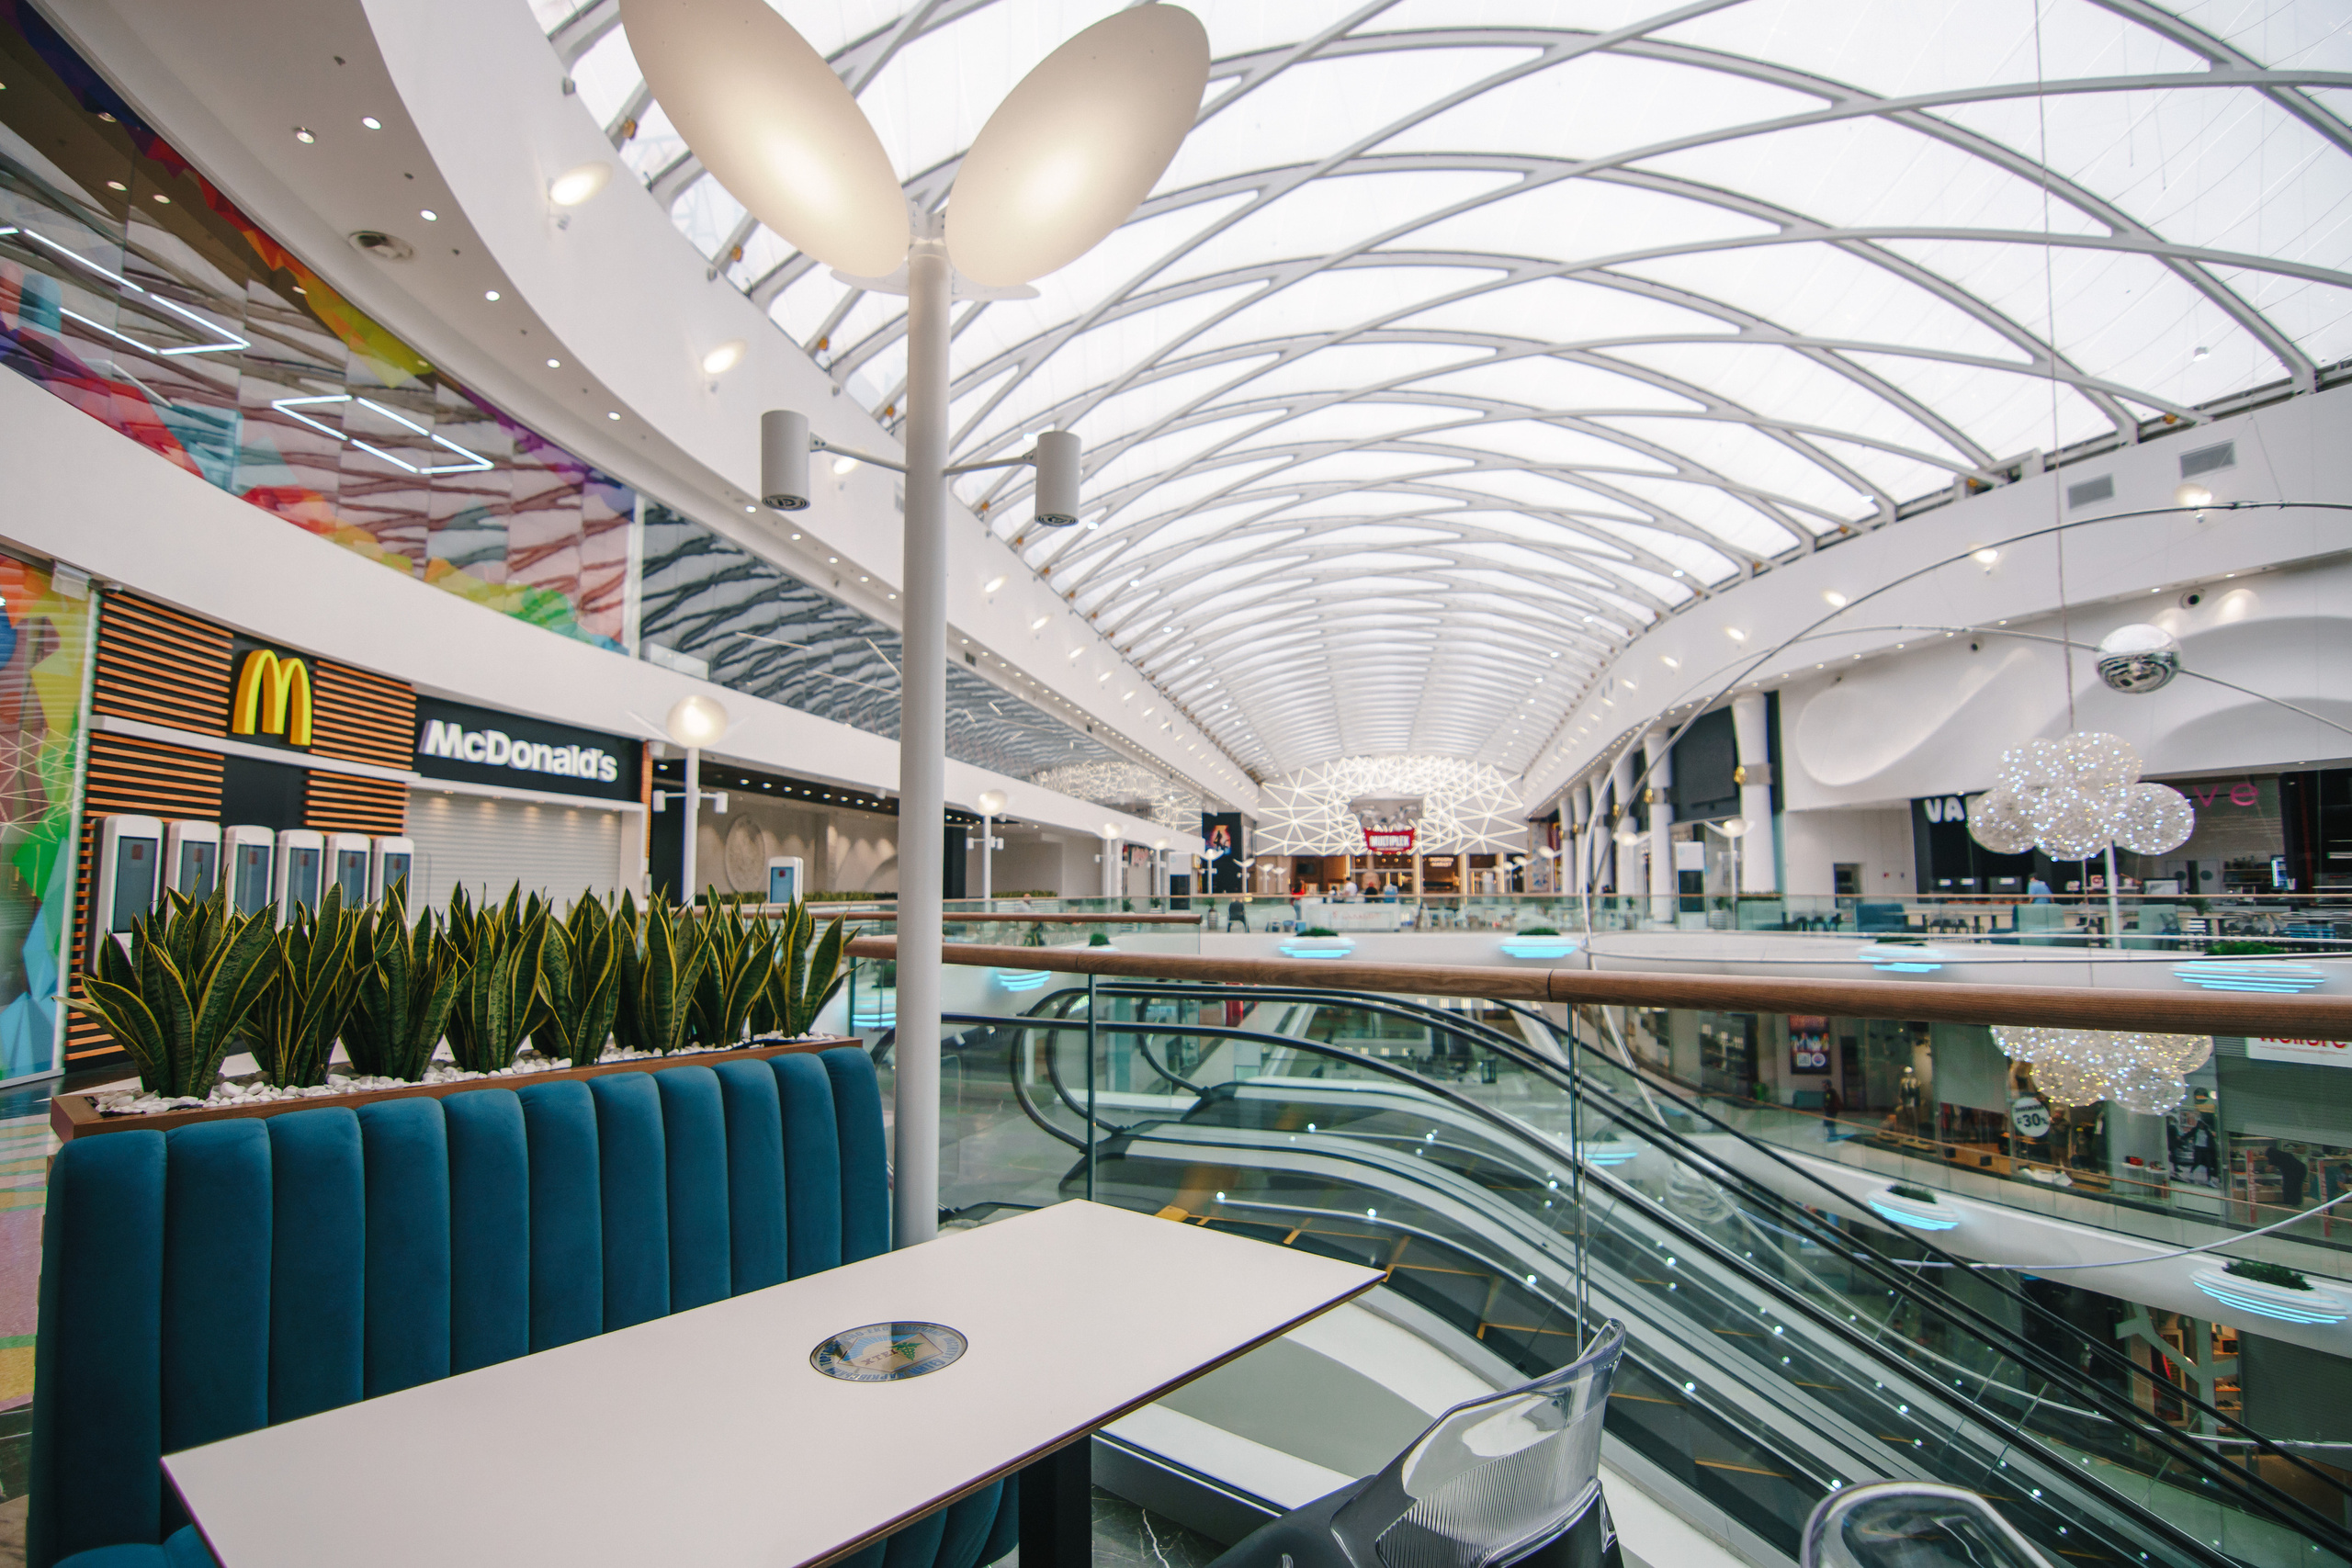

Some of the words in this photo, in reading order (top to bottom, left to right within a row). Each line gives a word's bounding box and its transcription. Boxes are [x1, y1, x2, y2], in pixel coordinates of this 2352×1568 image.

[232, 649, 312, 746] M
[420, 719, 617, 783] McDonald's
[1924, 796, 1967, 823] VA
[1369, 835, 1410, 847] MULTIPLEX
